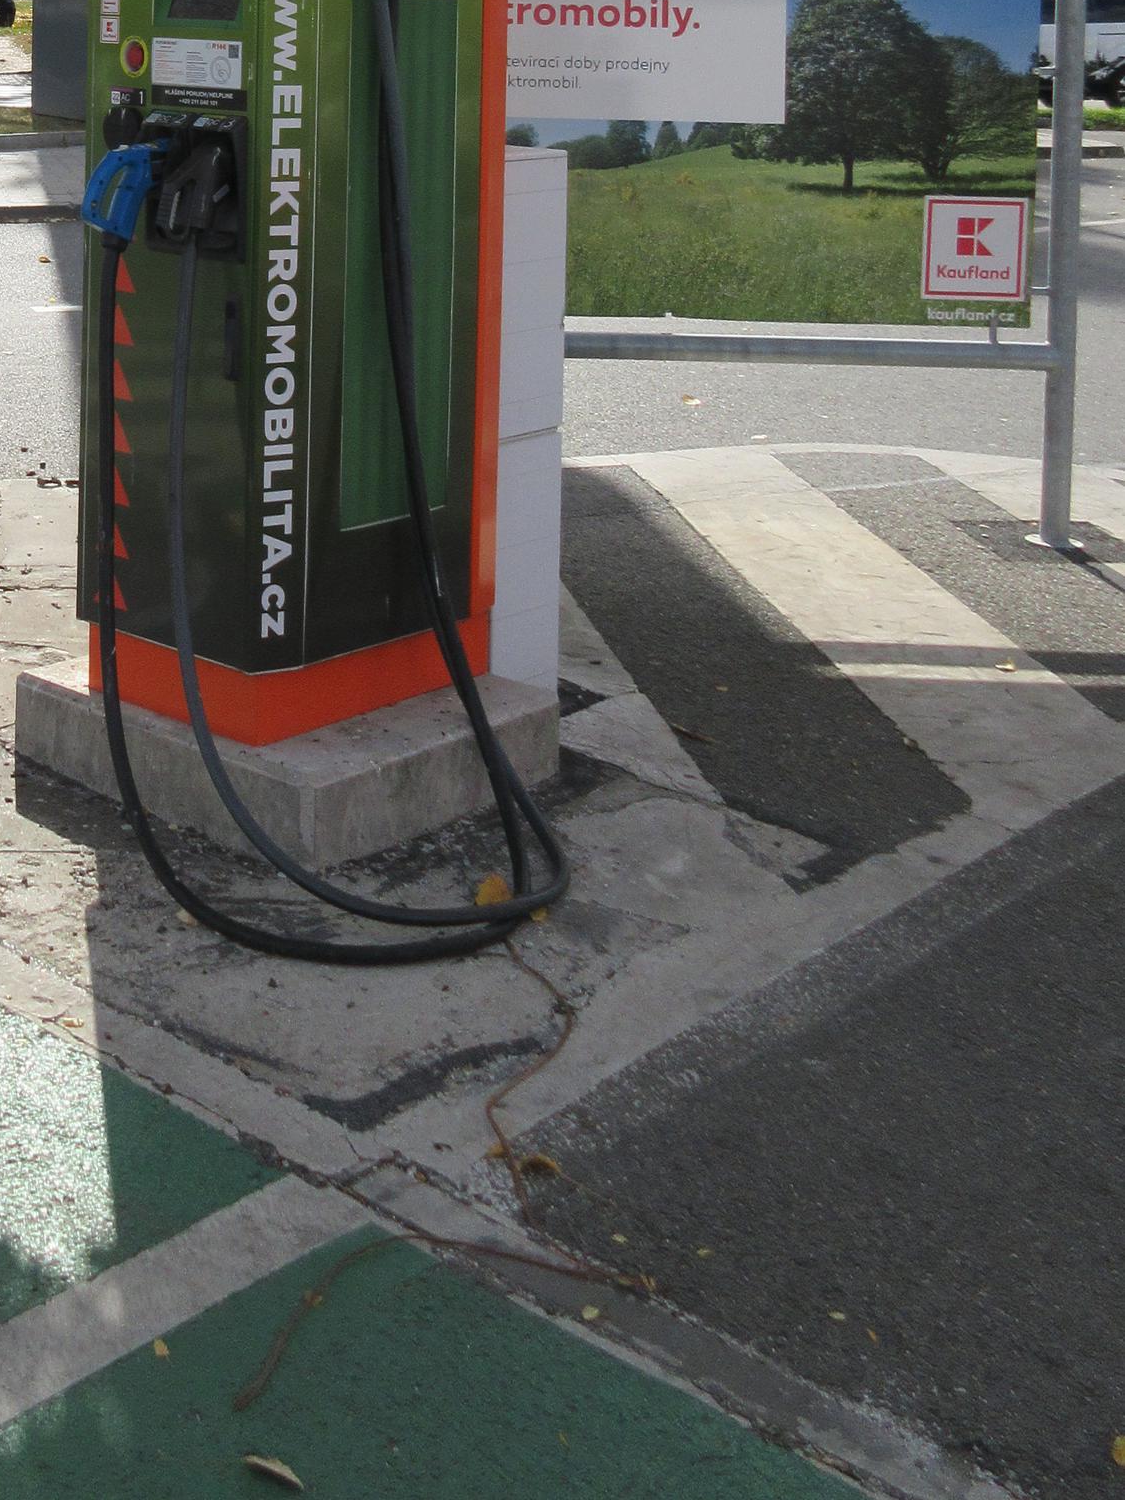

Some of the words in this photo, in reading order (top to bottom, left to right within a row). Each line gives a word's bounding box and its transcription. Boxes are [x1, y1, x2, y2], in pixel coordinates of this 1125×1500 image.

[564, 55, 601, 72] doby
[606, 56, 670, 74] prodejny
[508, 75, 581, 90] ktromobil.
[937, 265, 1010, 280] Kaufland
[927, 308, 1015, 322] kauflandcz
